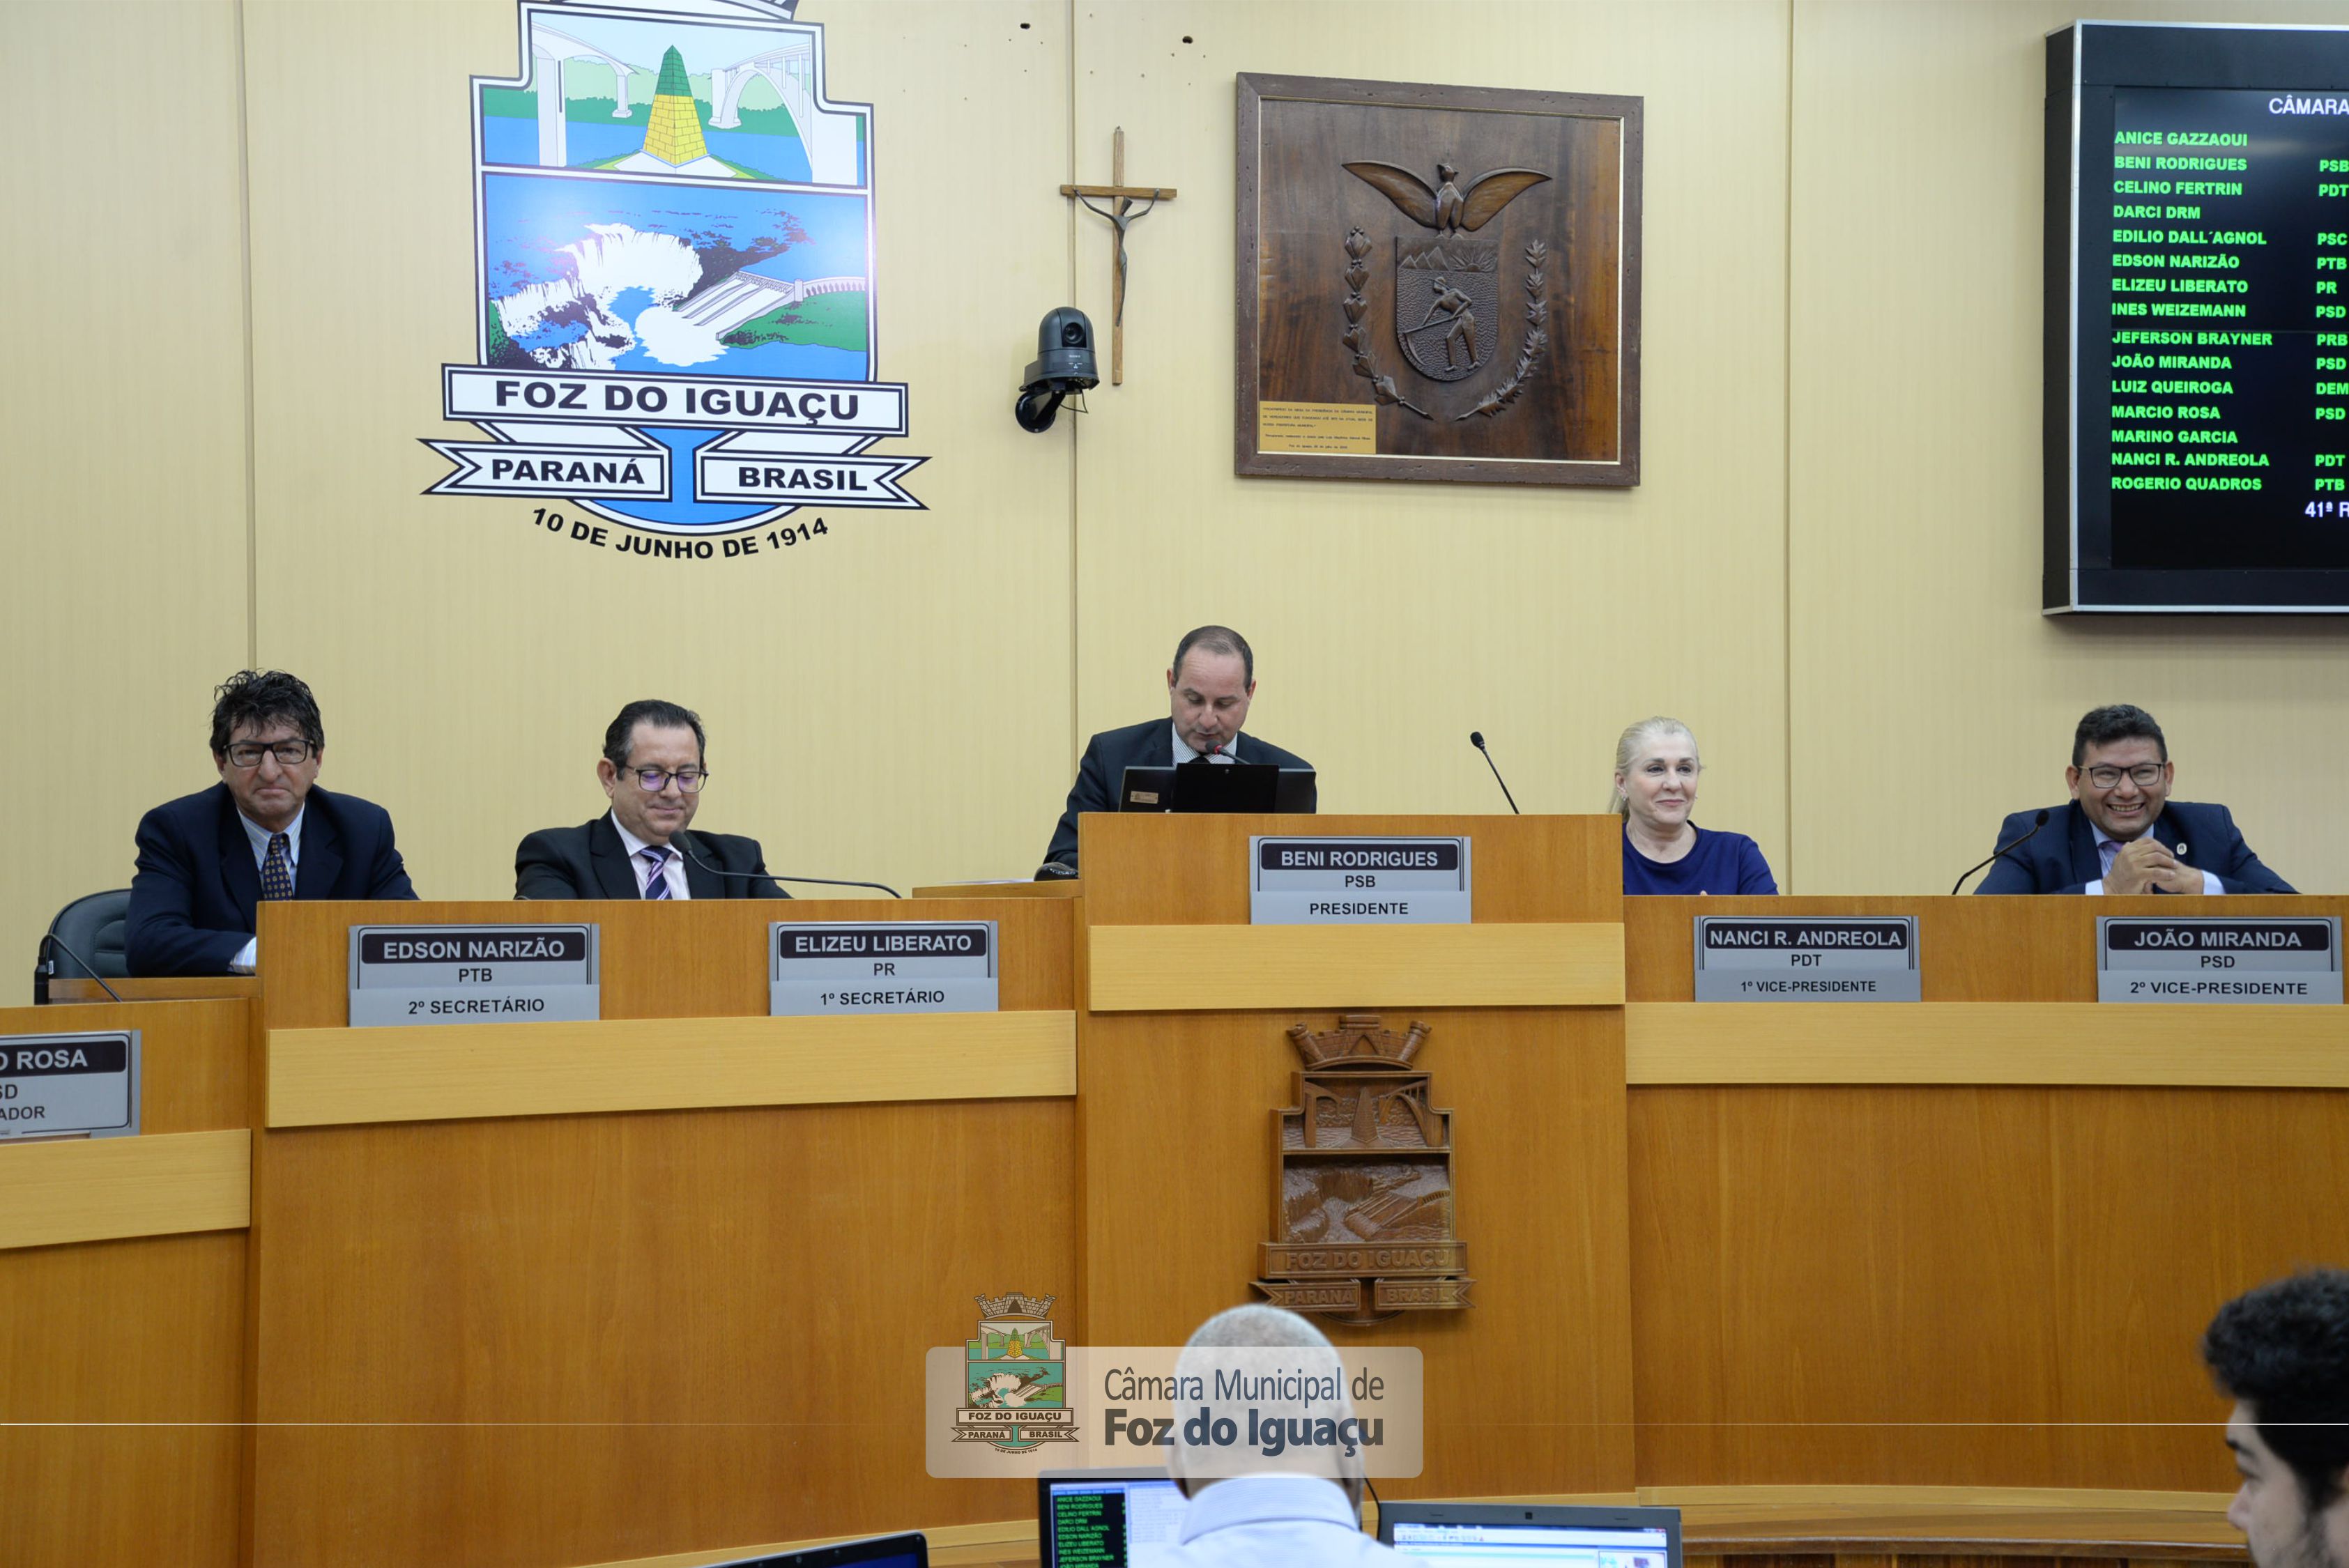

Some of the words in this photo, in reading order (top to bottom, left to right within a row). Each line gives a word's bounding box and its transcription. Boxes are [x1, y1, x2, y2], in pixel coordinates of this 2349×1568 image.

[2270, 95, 2349, 114] CÂMARA
[2115, 131, 2163, 145] ANICE
[2167, 132, 2248, 146] GAZZAOUI
[2115, 156, 2152, 169] BENI
[2157, 156, 2247, 170] RODRIGUES
[2320, 160, 2349, 172] PSB
[2115, 180, 2172, 194] CELINO
[2176, 181, 2242, 195] FERTRIN
[2320, 184, 2349, 197] PDT
[2113, 205, 2161, 218] DARCI
[2166, 206, 2201, 219] DRM
[2113, 229, 2164, 243] EDILIO
[2318, 233, 2348, 245] PSC
[2113, 254, 2165, 267] EDSON
[2170, 254, 2240, 268] NARIZÃO
[2318, 257, 2347, 270] PTB
[2113, 278, 2167, 291] ELIZEU
[2171, 279, 2249, 293] LIBERATO
[2317, 282, 2337, 294] PR
[2112, 302, 2148, 315] INES
[2152, 303, 2247, 316] WEIZEMANN
[2317, 305, 2346, 318] PSD
[2113, 332, 2193, 344] JEFERSON
[2198, 332, 2272, 345] BRAYNER
[2318, 333, 2348, 346] PRB
[2112, 353, 2155, 368] JOÃO
[2159, 356, 2232, 369] MIRANDA
[2317, 358, 2347, 369] PSD
[2113, 381, 2147, 393] LUIZ
[2152, 381, 2233, 394] QUEIROGA
[2317, 382, 2349, 394] DEM
[496, 380, 588, 410] FOZ
[604, 384, 668, 414] DO
[685, 387, 860, 425] IGUAÇU
[2112, 406, 2173, 418] MARCIO
[2178, 406, 2221, 419] ROSA
[2316, 407, 2346, 420] PSD
[2112, 430, 2174, 443] MARINO
[2179, 430, 2238, 443] GARCIA
[2112, 453, 2161, 465] NANCI
[2166, 453, 2180, 466] R.
[2185, 453, 2270, 466] ANDREOLA
[2316, 454, 2346, 466] PDT
[491, 458, 645, 485] PARANÁ
[738, 468, 869, 491] BRASIL
[2112, 477, 2182, 490] ROGERIO
[2186, 477, 2262, 490] QUADROS
[2316, 478, 2345, 491] PTB
[532, 507, 565, 532] 10
[571, 522, 607, 548] DE
[615, 535, 714, 560] JUNHO
[723, 536, 759, 558] DE
[766, 518, 829, 550] 1914
[1282, 852, 1324, 866] BENI
[1331, 852, 1437, 866] RODRIGUES
[1345, 875, 1375, 887] PSB
[1310, 903, 1408, 914] PRESIDENTE
[796, 937, 866, 952] ELIZEU
[874, 935, 971, 951] LIBERATO
[1711, 931, 1768, 945] NANCI
[1775, 931, 1791, 945] R.
[1797, 931, 1901, 946] ANDREOLA
[2134, 929, 2194, 946] JOÃO
[2201, 932, 2302, 946] MIRANDA
[384, 942, 460, 959] EDSON
[469, 937, 564, 958] NARIZÃO
[1791, 955, 1821, 966] PDT
[2201, 956, 2235, 968] PSD
[459, 969, 492, 982] PTB
[874, 963, 895, 976] PR
[1757, 981, 1876, 992] VICE-PRESIDENTE
[2151, 983, 2306, 994] VICE-PRESIDENTE
[840, 988, 944, 1005] SECRETÁRIO
[431, 996, 544, 1013] SECRETÁRIO
[17, 1050, 87, 1069] ROSA
[1286, 1252, 1326, 1269] FOZ
[1333, 1251, 1363, 1268] DO
[1368, 1249, 1449, 1270] IGUAÇU
[1386, 1287, 1450, 1302] BRASIL
